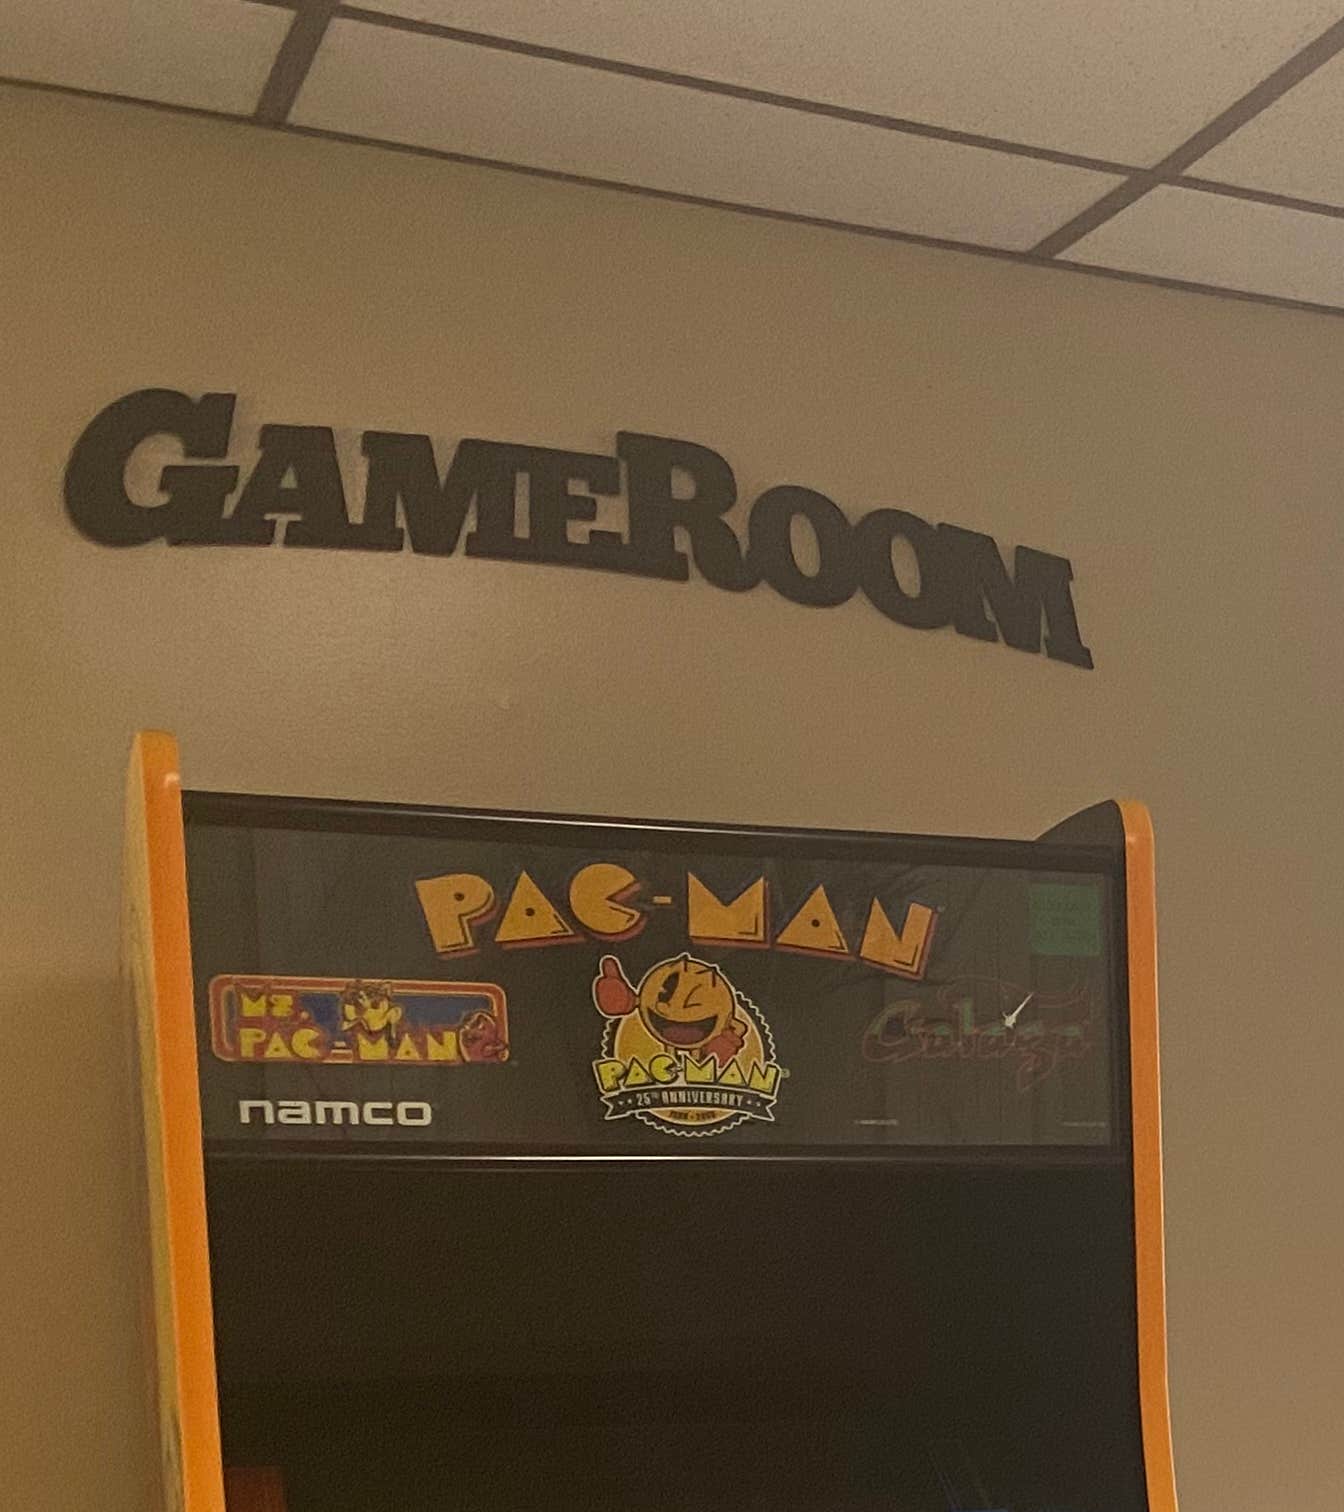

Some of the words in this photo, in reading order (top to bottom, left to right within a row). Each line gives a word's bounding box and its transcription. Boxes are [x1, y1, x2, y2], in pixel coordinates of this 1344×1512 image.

[415, 862, 938, 980] PAC-MAN
[239, 1028, 458, 1061] PAC-MAN
[594, 1053, 780, 1096] PAC-MAN
[239, 1100, 432, 1126] namco
[662, 1090, 744, 1108] ANNIVERSARY
